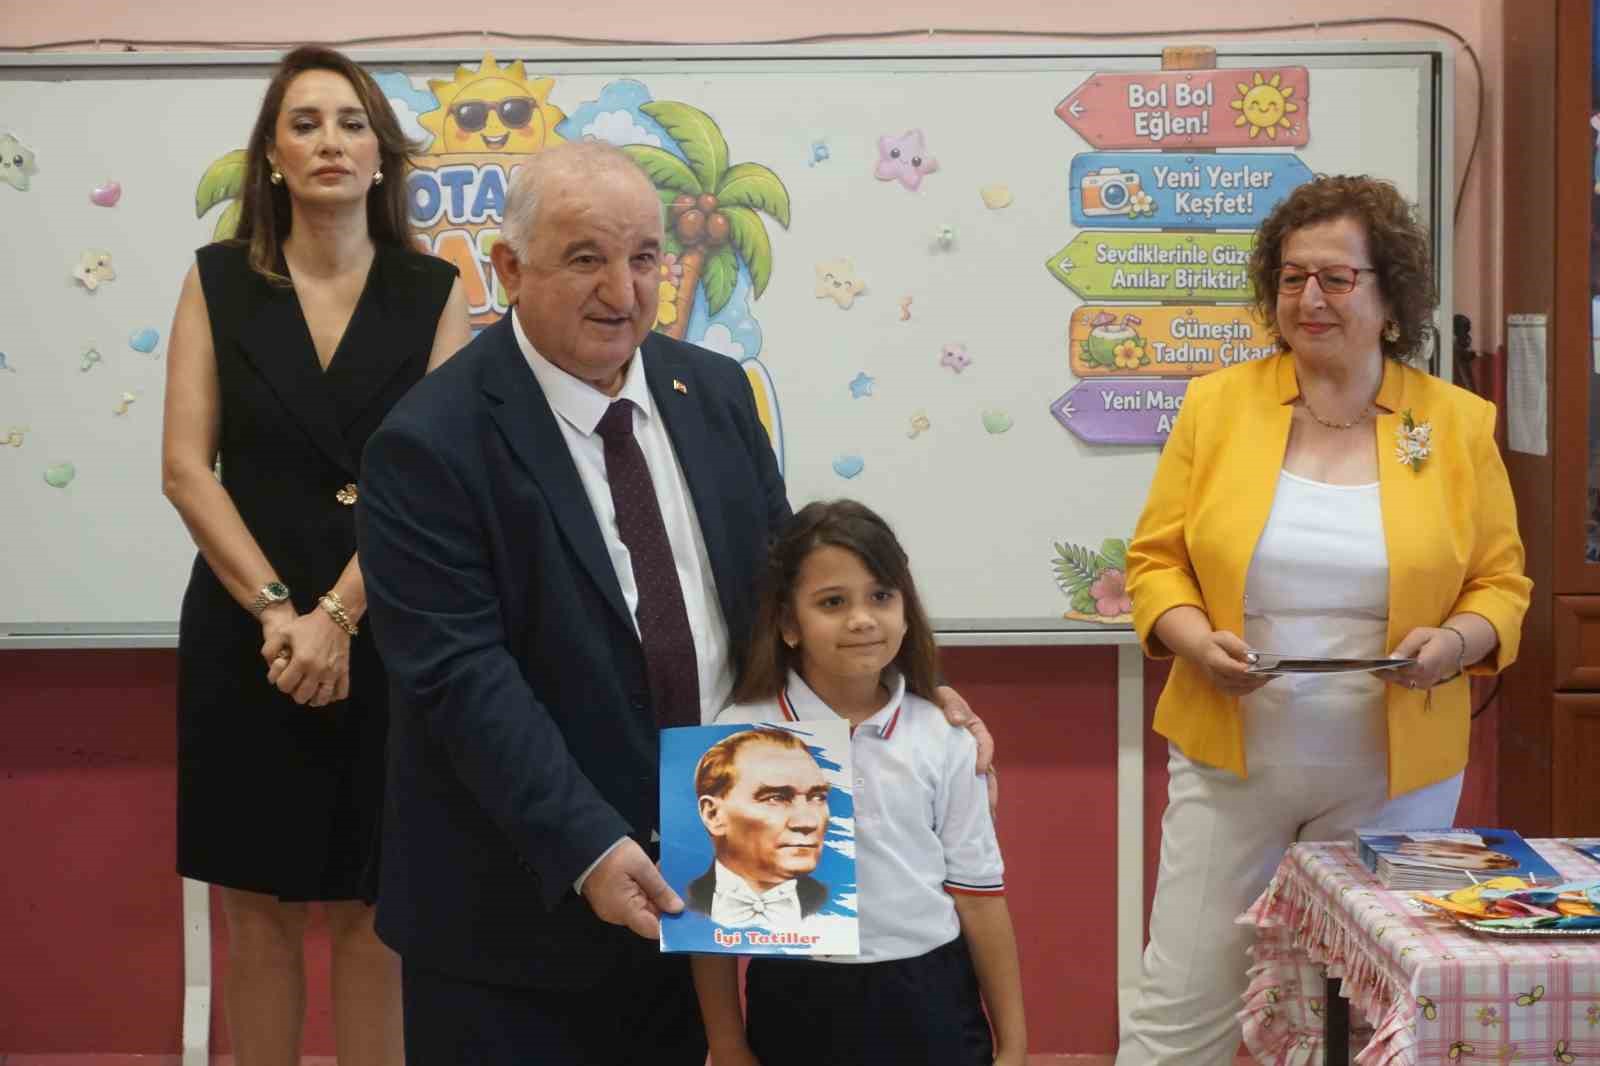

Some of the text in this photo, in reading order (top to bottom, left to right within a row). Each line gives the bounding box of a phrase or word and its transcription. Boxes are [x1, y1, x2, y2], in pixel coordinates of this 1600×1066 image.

[1128, 83, 1213, 108] Bol Bol
[1135, 111, 1209, 139] Eğlen!
[1153, 166, 1273, 188] Yeni Yerler
[1175, 191, 1253, 217] Keşfet!
[1096, 244, 1249, 264] Sevdiklerinle Güz
[1112, 269, 1248, 289] Anılar Biriktir!
[1171, 318, 1251, 343] Güneşin
[1152, 342, 1213, 362] Tadını
[1101, 390, 1184, 410] Yeni Mac
[715, 928, 821, 947] İyi Tatiller
